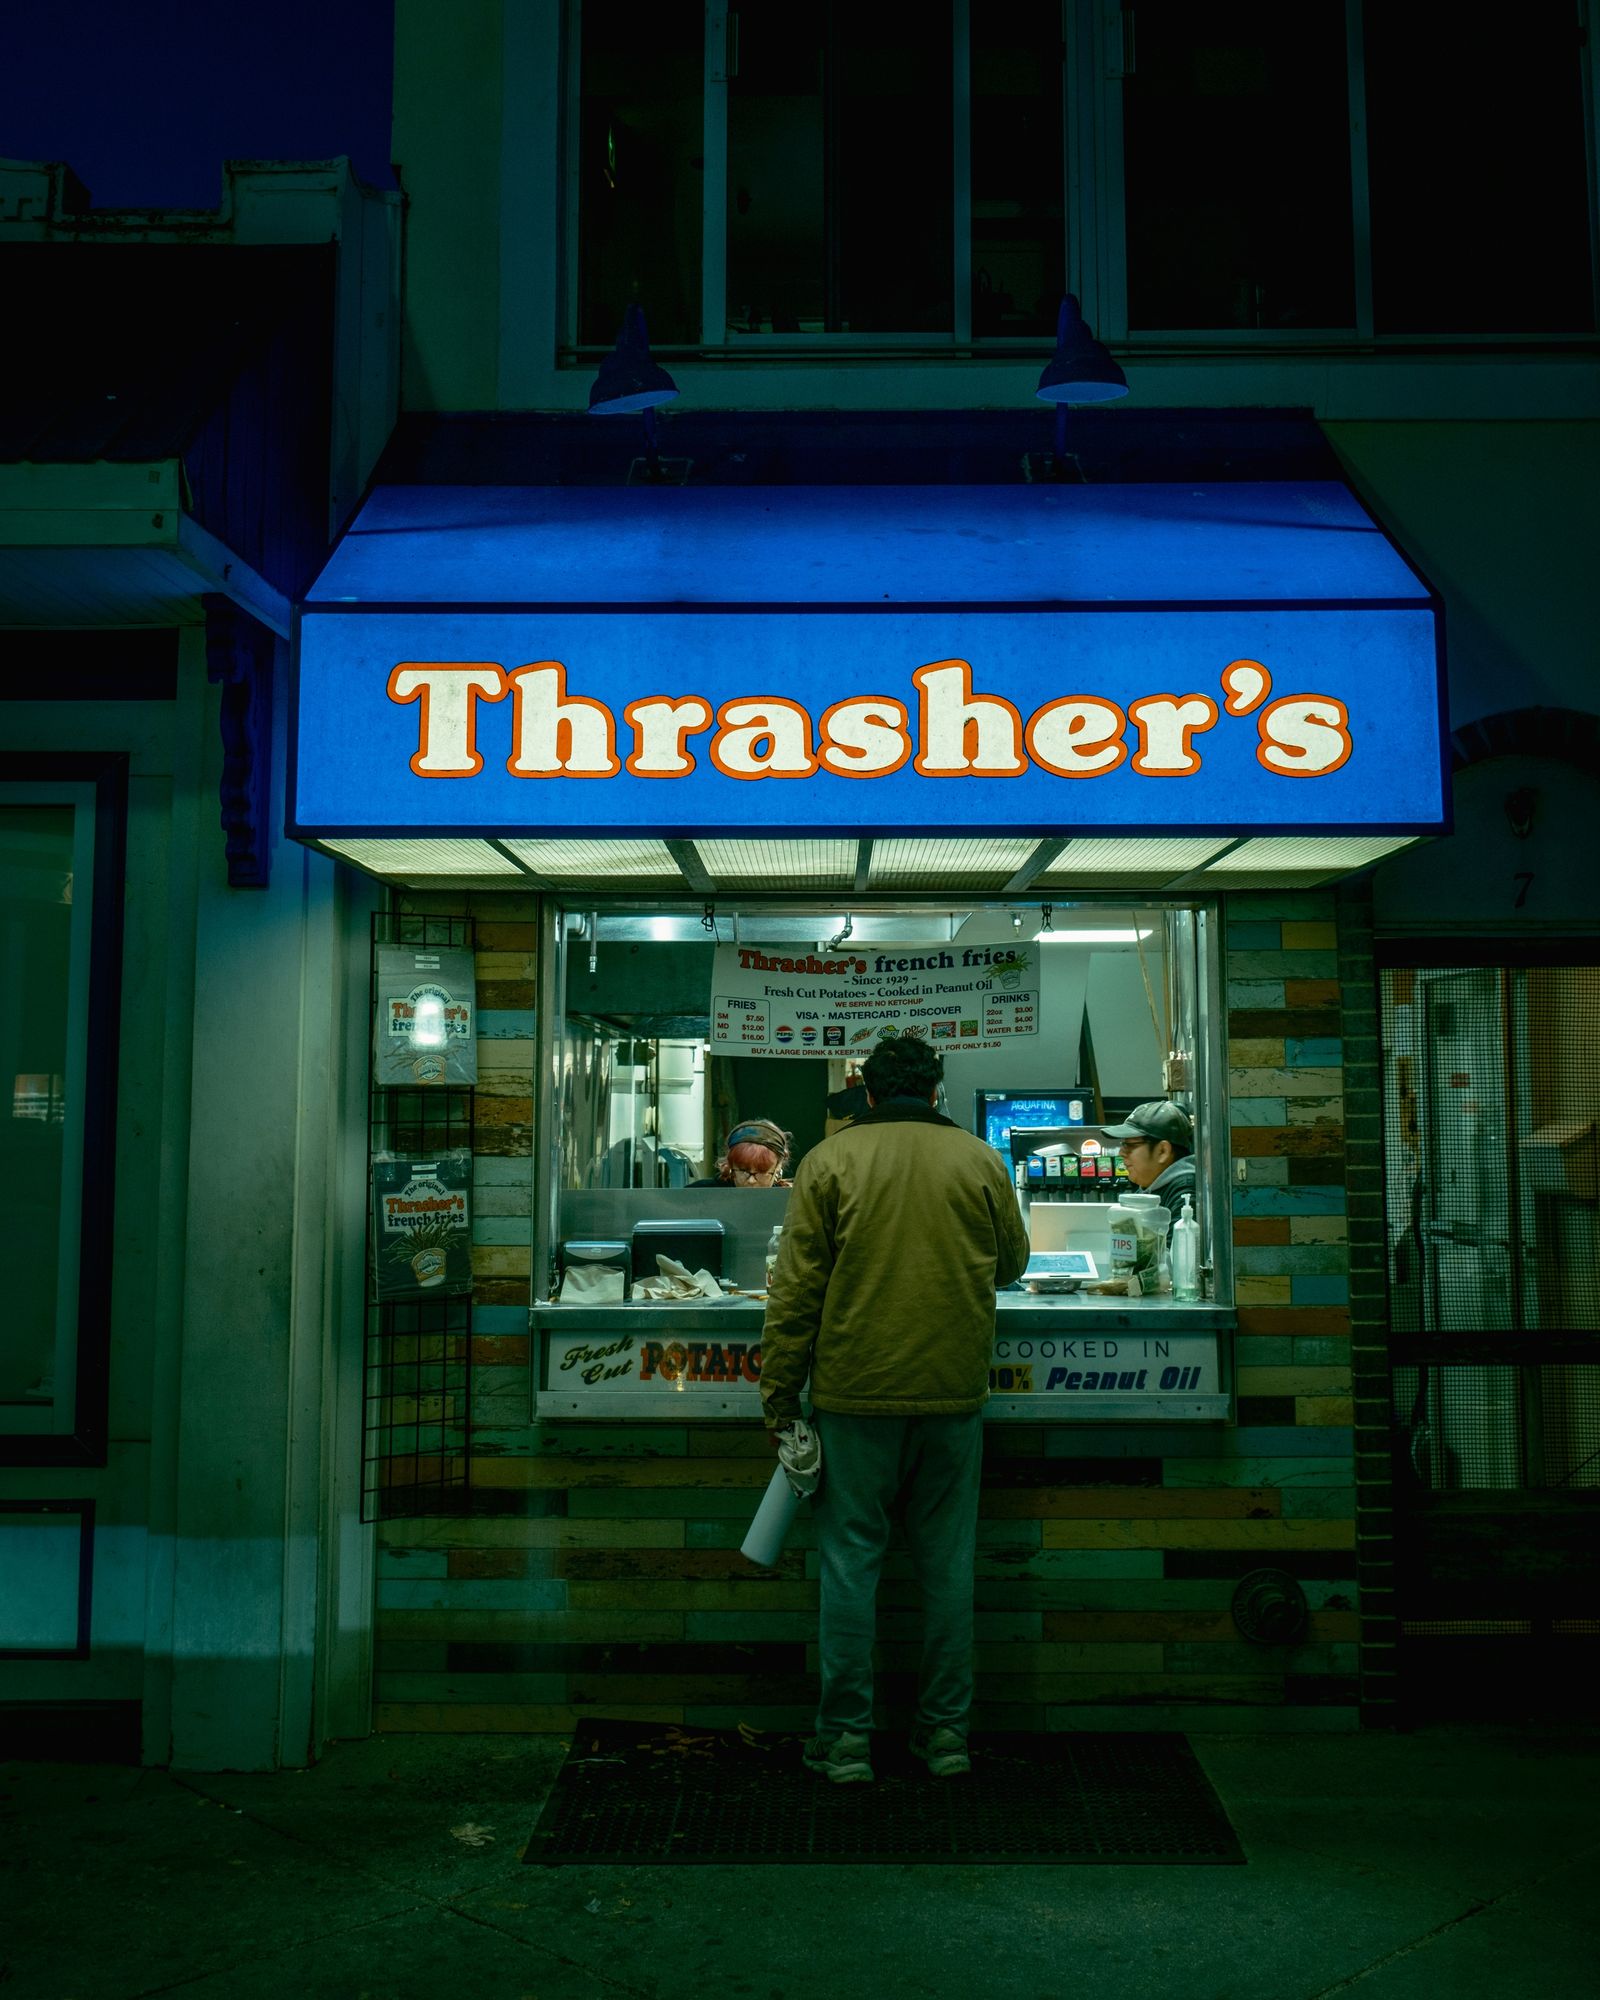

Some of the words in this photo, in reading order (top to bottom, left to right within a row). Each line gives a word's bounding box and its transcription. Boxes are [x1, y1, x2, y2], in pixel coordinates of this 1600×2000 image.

[386, 659, 1354, 778] Thrasher's
[1513, 871, 1535, 909] 7
[738, 949, 867, 975] Thrasher's
[874, 952, 954, 973] french
[962, 948, 1016, 967] fries
[764, 986, 794, 997] Fresh
[796, 988, 816, 998] Cut
[819, 988, 867, 999] Potatoes
[877, 985, 919, 998] Cooked
[922, 985, 933, 995] in
[935, 983, 973, 994] Peanut
[976, 979, 993, 990] Oil
[852, 975, 882, 986] Since
[886, 976, 909, 986] 1929
[410, 990, 424, 1002] The
[424, 986, 451, 1004] original
[888, 998, 924, 1006] KETCHUP
[991, 993, 1030, 1004] DRINKS
[727, 1000, 757, 1010] FRIES
[795, 1011, 819, 1020] VISA
[828, 1009, 900, 1020] MASTERCARD
[909, 1005, 962, 1017] DISCOVER
[717, 1012, 729, 1020] SM
[986, 1027, 1012, 1035] WATER
[775, 1048, 801, 1056] LARGE
[962, 1042, 982, 1050] ONLY
[1011, 1100, 1057, 1111] AQUAFINA
[405, 1185, 417, 1197] The
[418, 1180, 446, 1195] original
[386, 1195, 465, 1214] Thrasher's
[388, 1213, 431, 1227] french
[434, 1212, 465, 1225] fries
[1111, 1239, 1132, 1250] TIPS
[559, 1334, 634, 1371] Fresh
[996, 1340, 1118, 1359] COOKED
[1143, 1341, 1170, 1358] IN
[640, 1341, 763, 1383] POTATO
[581, 1358, 634, 1385] Cut
[1045, 1367, 1148, 1390] Peanut
[1159, 1366, 1202, 1390] Oil
